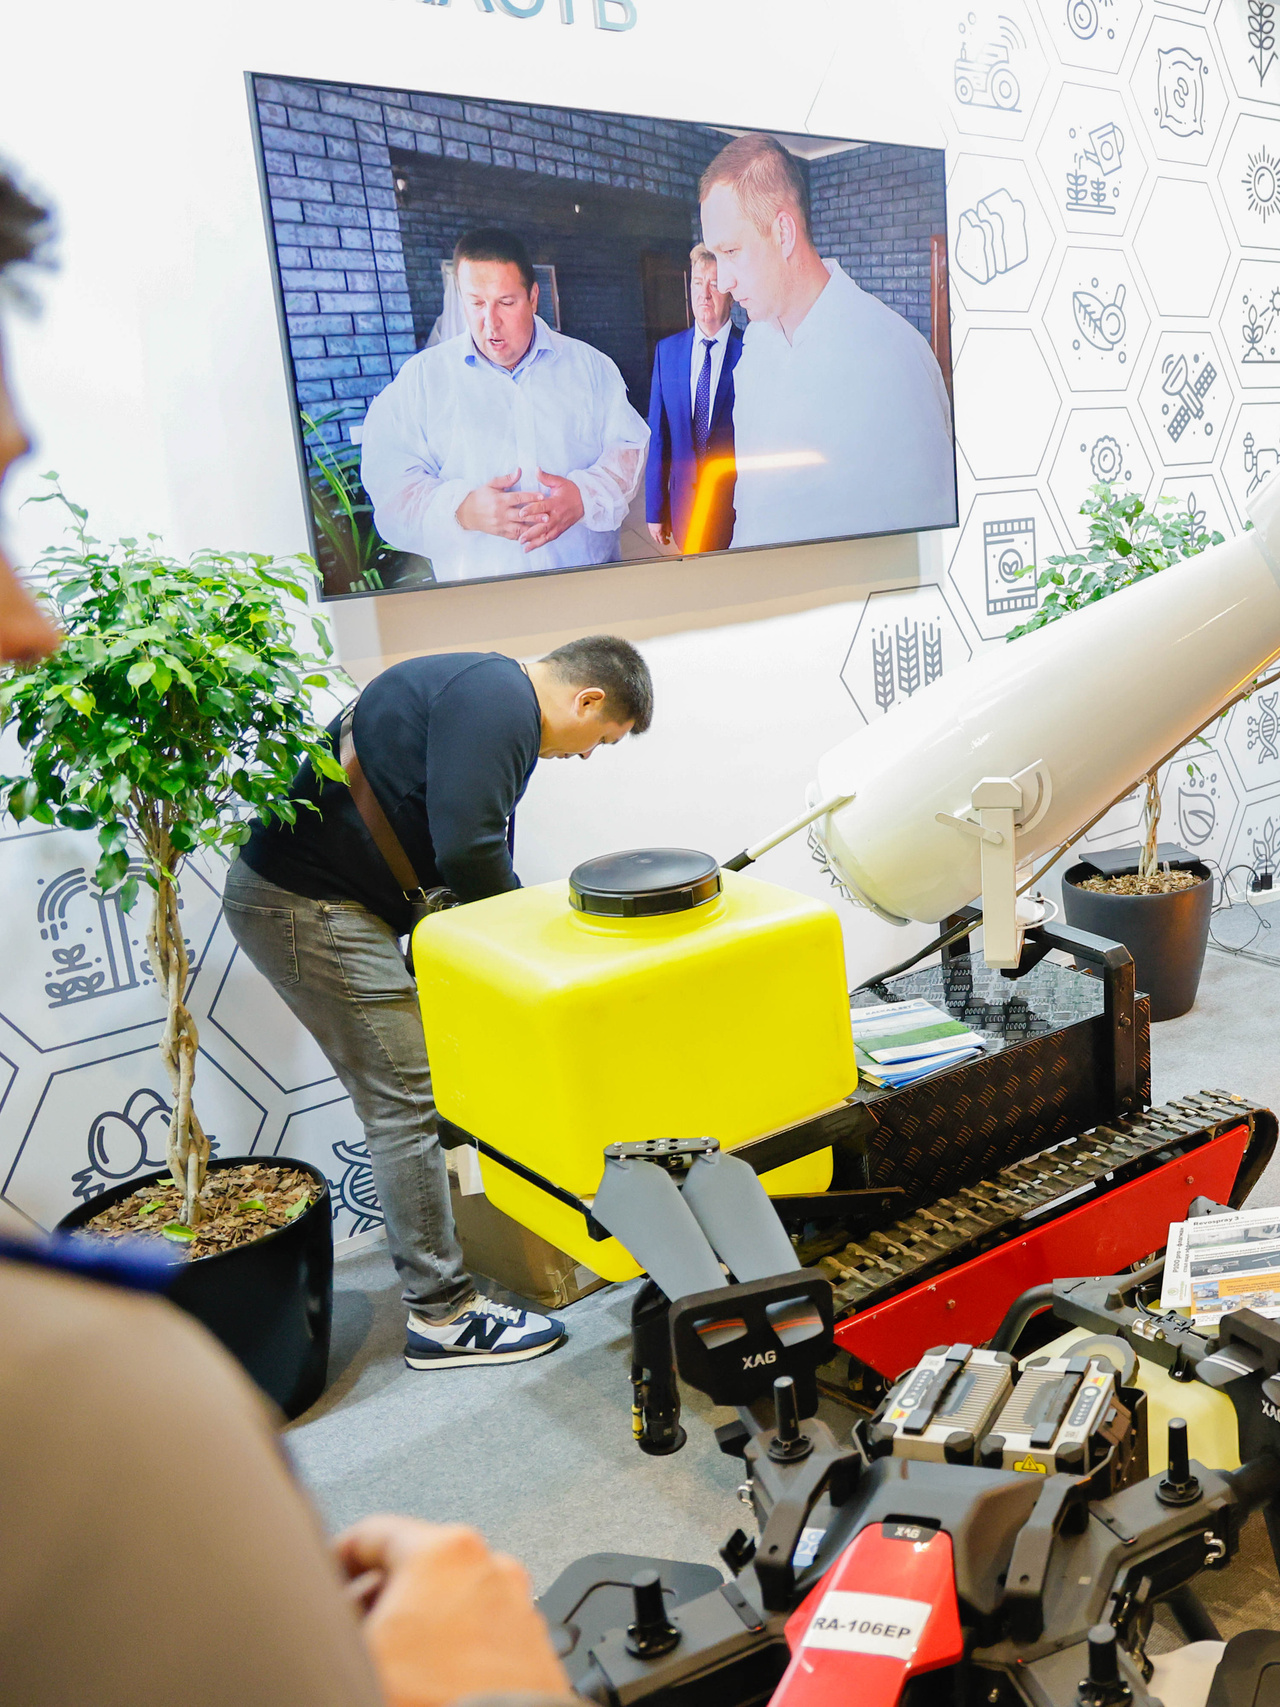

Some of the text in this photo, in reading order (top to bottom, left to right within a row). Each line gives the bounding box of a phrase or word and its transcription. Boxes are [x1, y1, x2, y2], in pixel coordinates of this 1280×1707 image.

[1193, 1217, 1233, 1226] Revospray
[453, 1318, 508, 1350] N
[742, 1350, 776, 1370] XAG
[813, 1617, 911, 1639] RA-106EP
